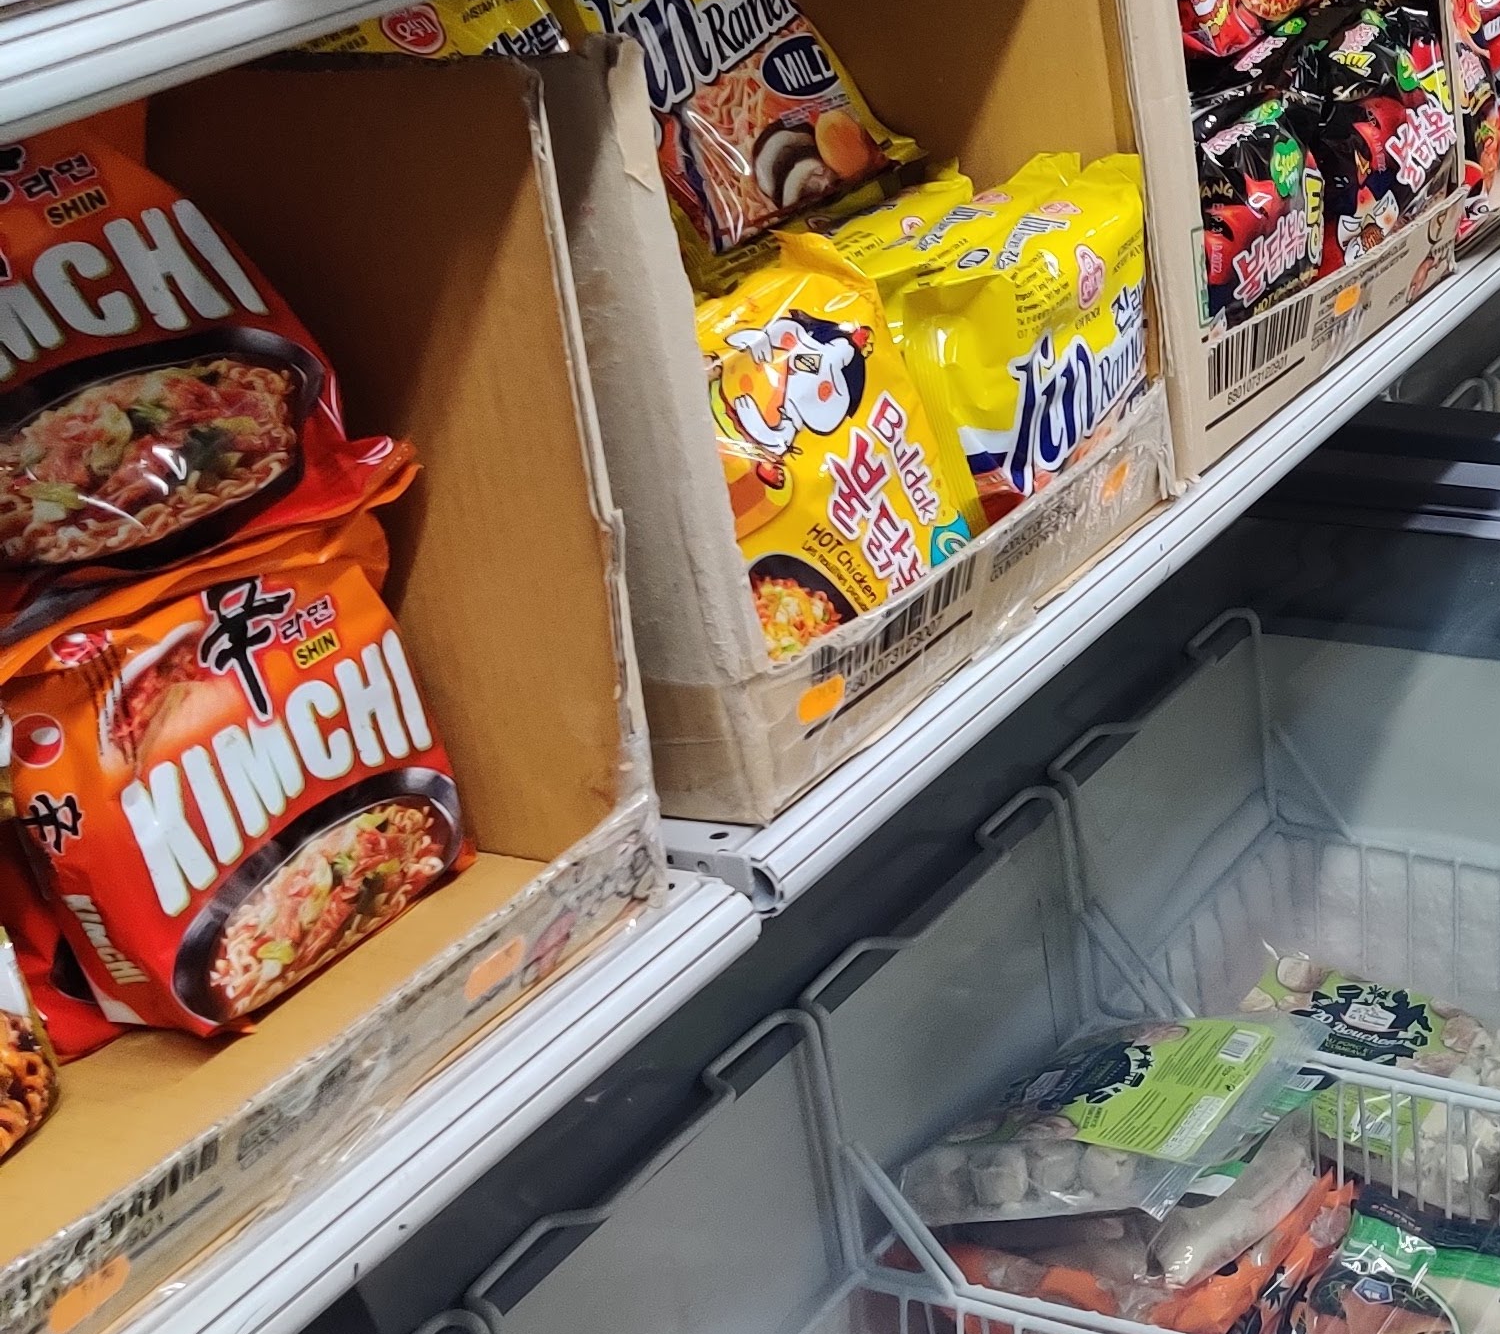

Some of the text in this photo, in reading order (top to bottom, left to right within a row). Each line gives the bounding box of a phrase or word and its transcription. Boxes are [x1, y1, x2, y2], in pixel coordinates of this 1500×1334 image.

[772, 45, 836, 92] MILD
[20, 153, 98, 203] 라면
[46, 185, 110, 226] SHIN
[872, 397, 937, 524] Buldak
[806, 522, 878, 604] HOT Chicken
[278, 594, 334, 641] 라면
[199, 574, 296, 723] 辛
[296, 631, 338, 667] SHIN
[120, 628, 434, 917] KIMCHI
[65, 892, 151, 987] KIMCHI
[1316, 1008, 1335, 1025] 20
